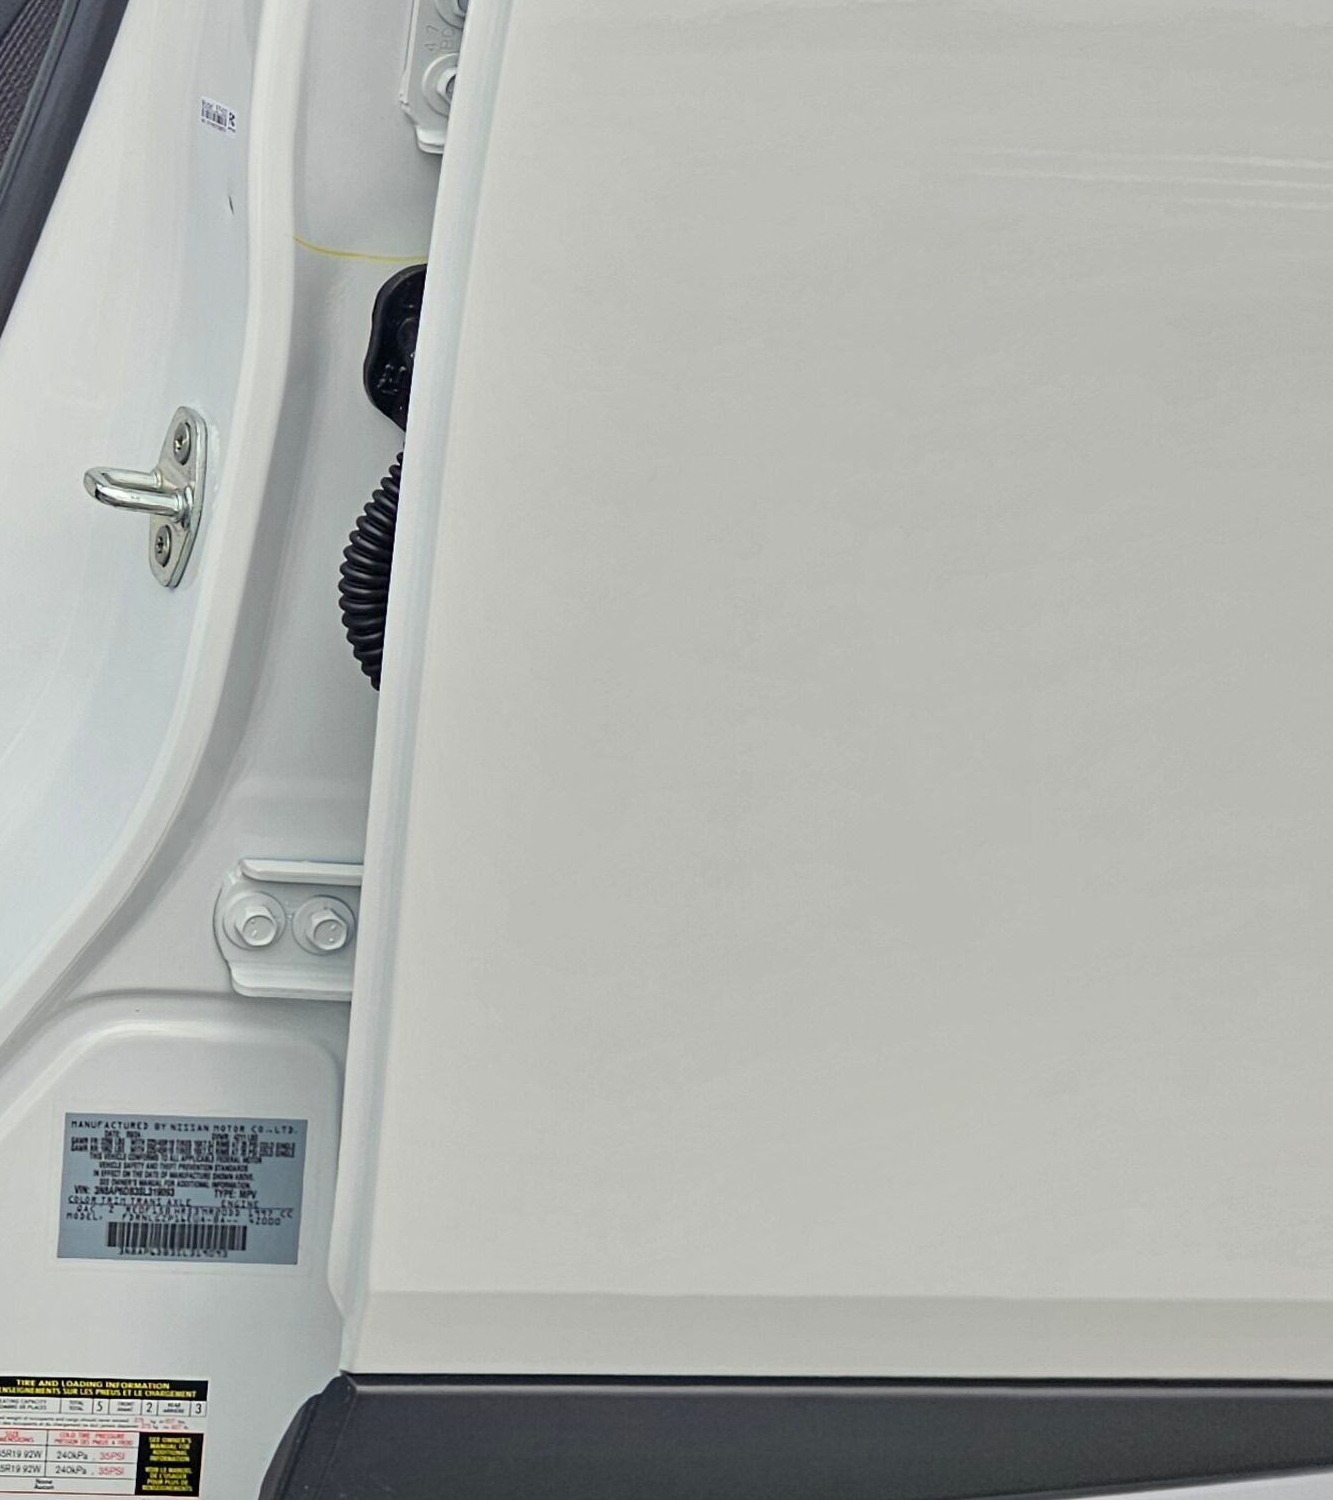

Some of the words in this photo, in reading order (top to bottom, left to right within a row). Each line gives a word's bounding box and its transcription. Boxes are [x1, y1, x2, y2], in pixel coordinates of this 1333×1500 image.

[71, 1120, 149, 1131] MANUFACTURED
[154, 1122, 167, 1131] BY
[213, 1125, 245, 1133] MOTOR
[239, 1190, 257, 1199] MPV
[68, 1195, 96, 1204] COLOR
[101, 1196, 126, 1205] TRIM
[167, 1198, 192, 1207] AXLE
[38, 1379, 59, 1387] AND
[61, 1380, 103, 1388] LOADING
[105, 1381, 170, 1390] INFORMATION
[63, 1387, 78, 1395] SUR
[95, 1388, 121, 1396] PNEUS
[145, 1390, 197, 1398] CHARGEMENT
[96, 1401, 103, 1411] 5
[146, 1402, 153, 1413] 2
[195, 1403, 202, 1414] 3
[24, 1450, 43, 1459] 92W
[56, 1451, 88, 1460] 240kPa
[100, 1452, 125, 1460] 35PSI
[23, 1465, 42, 1473] 92W
[55, 1465, 87, 1475] 240kPa
[98, 1466, 124, 1475] 35PSI
